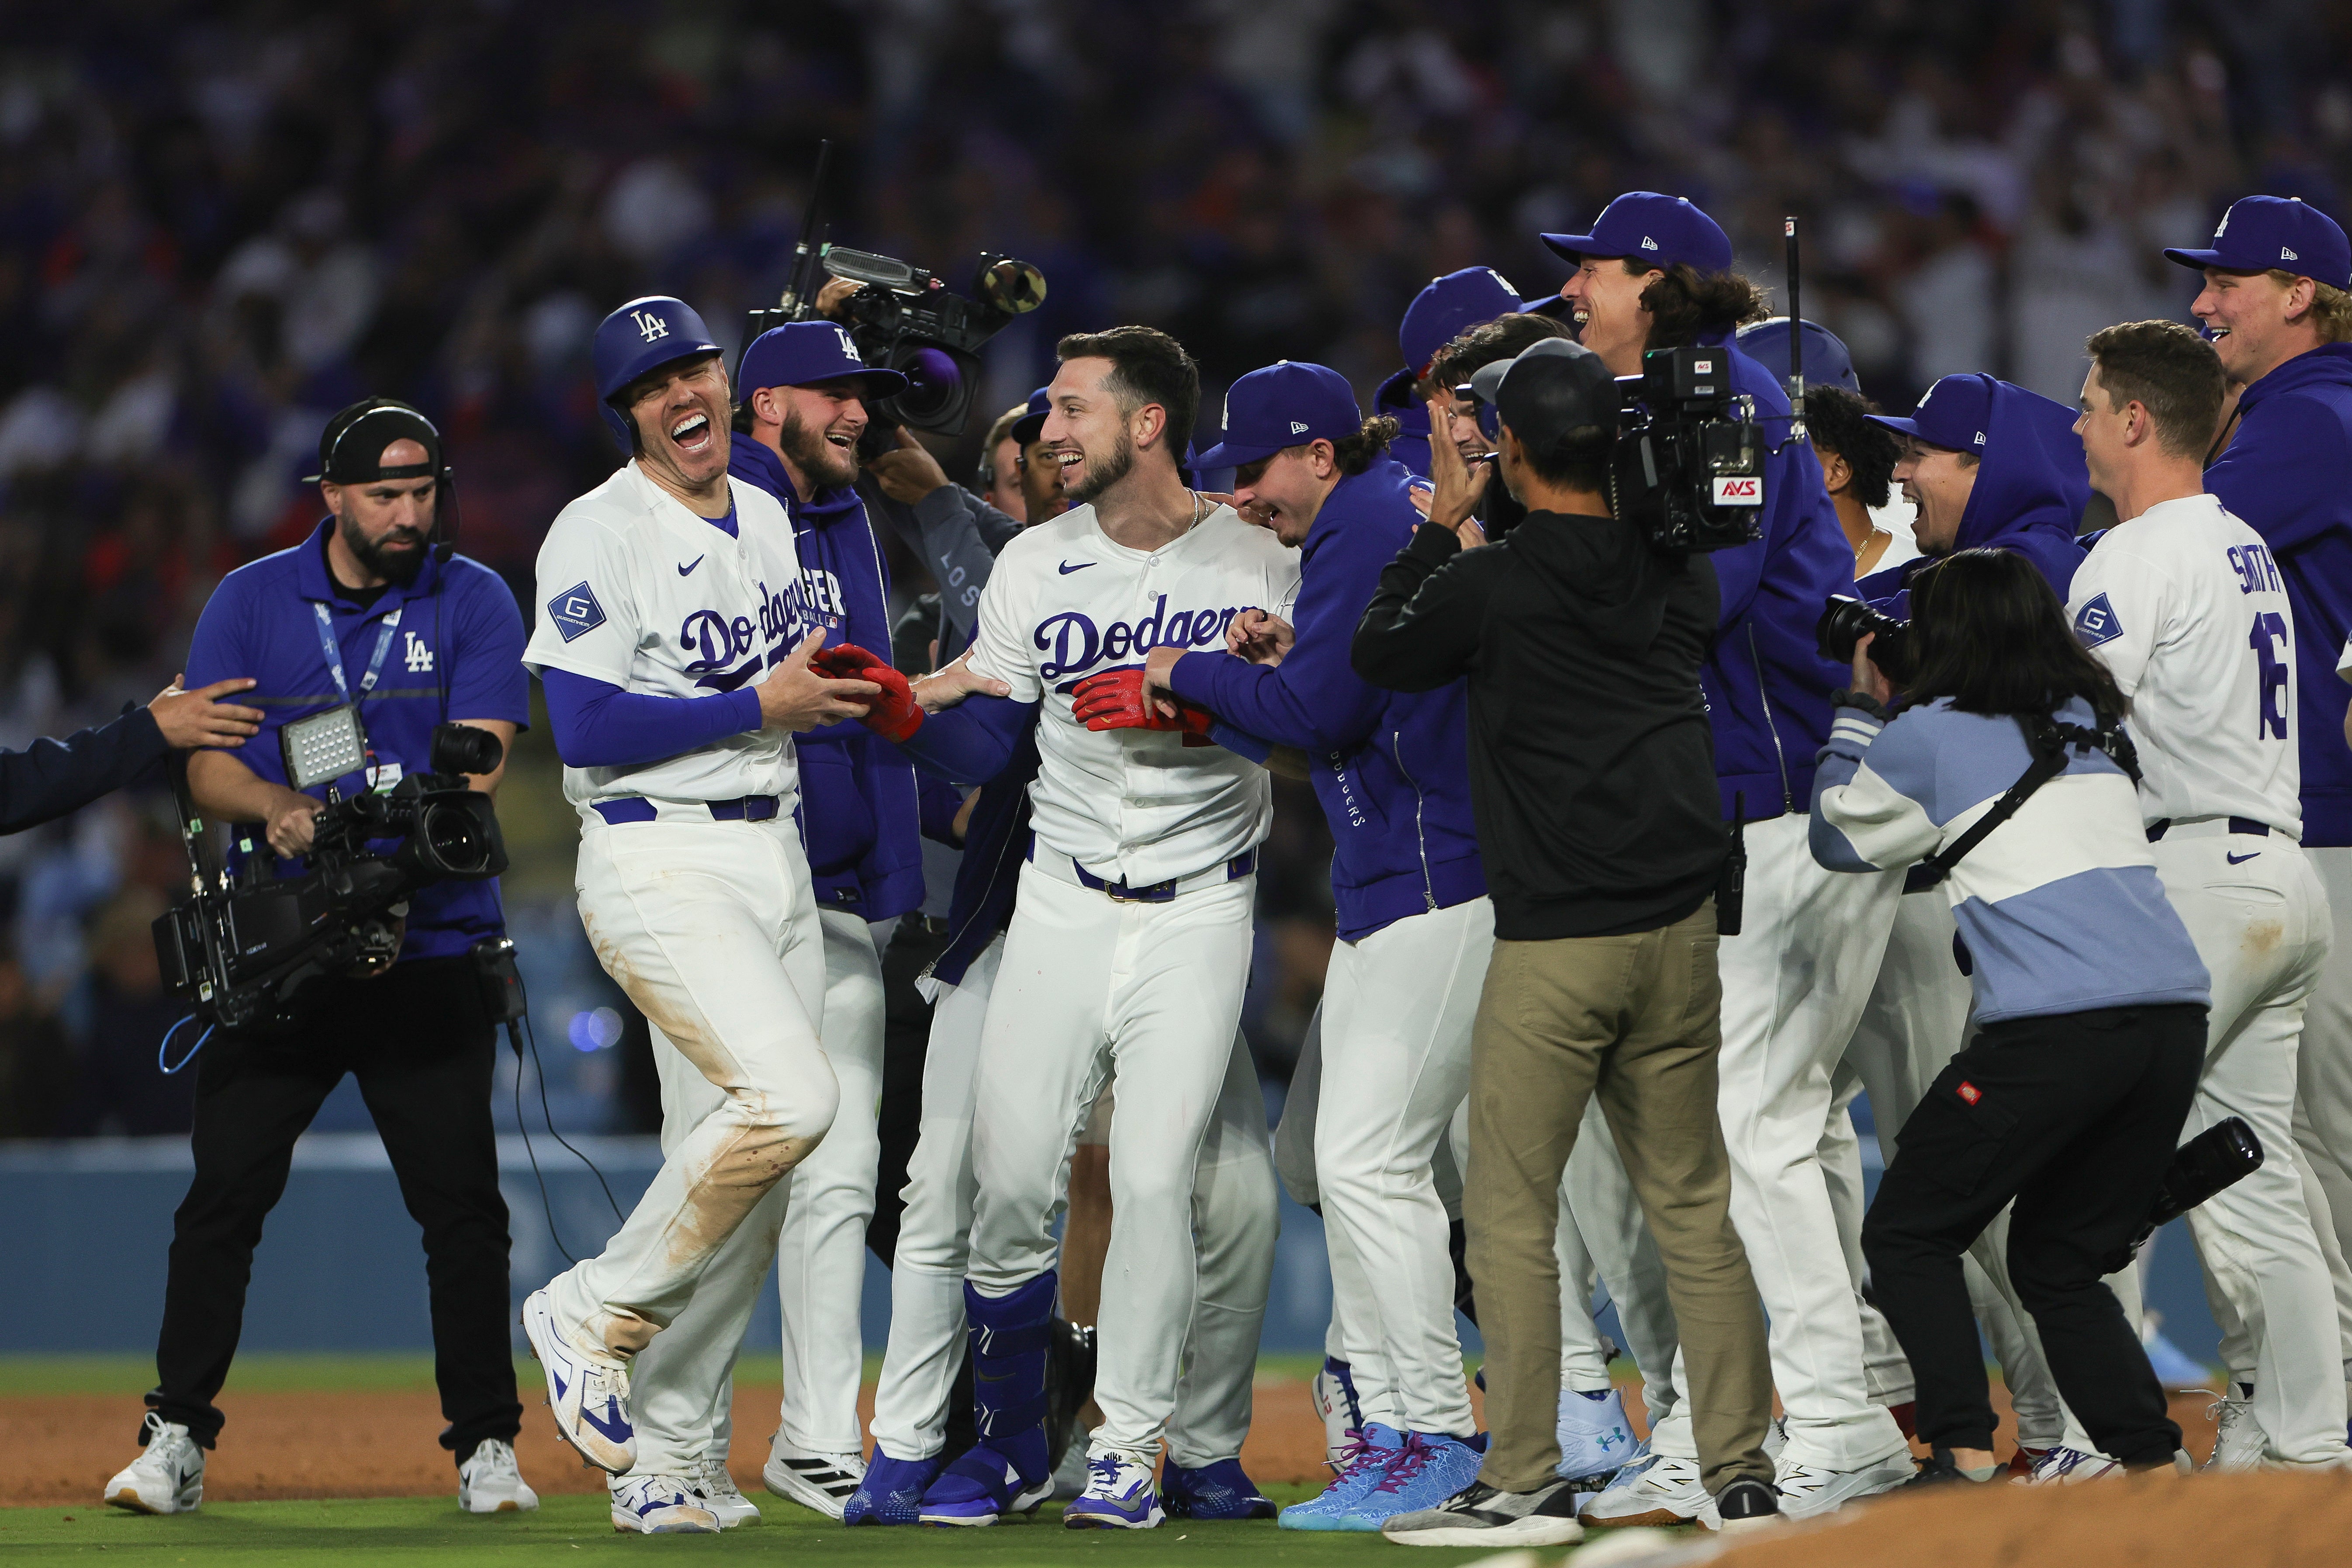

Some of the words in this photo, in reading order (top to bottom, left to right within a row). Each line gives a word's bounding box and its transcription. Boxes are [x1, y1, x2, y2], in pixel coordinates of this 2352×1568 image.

[630, 310, 669, 343] LA
[834, 328, 861, 362] LA
[1722, 481, 1755, 496] AVS
[941, 550, 980, 606] LOS
[556, 615, 590, 627] GUGGENHEIM
[565, 596, 590, 618] G
[801, 609, 823, 625] BALL
[2084, 607, 2107, 630] G
[680, 577, 801, 673] Dodger
[1034, 594, 1259, 680] Dodger
[405, 631, 433, 672] LA
[2249, 611, 2288, 740] 16
[1331, 751, 1366, 827] DODGERS
[1103, 1451, 1123, 1463] NIKE
